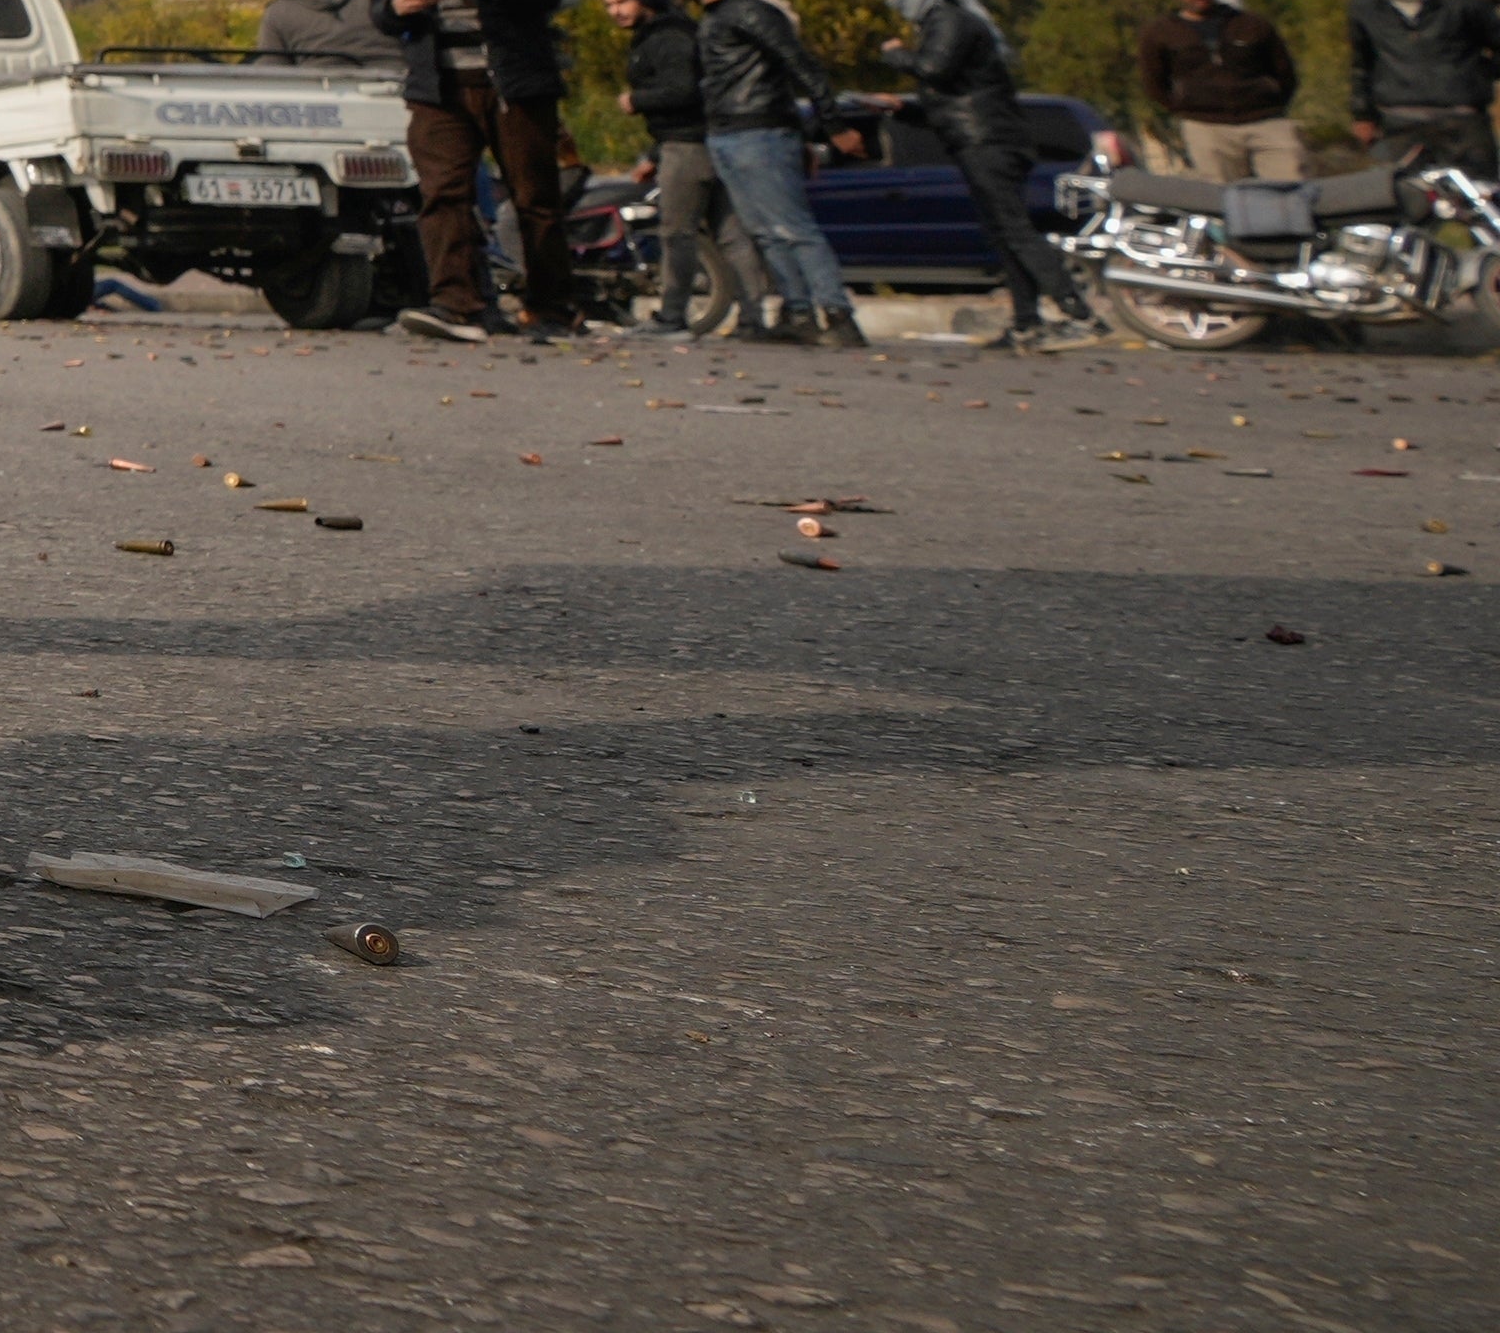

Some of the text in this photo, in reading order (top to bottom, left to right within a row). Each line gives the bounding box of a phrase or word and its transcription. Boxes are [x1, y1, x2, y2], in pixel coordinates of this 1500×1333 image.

[156, 101, 343, 128] CHANGHE
[197, 179, 312, 201] 61 35714
